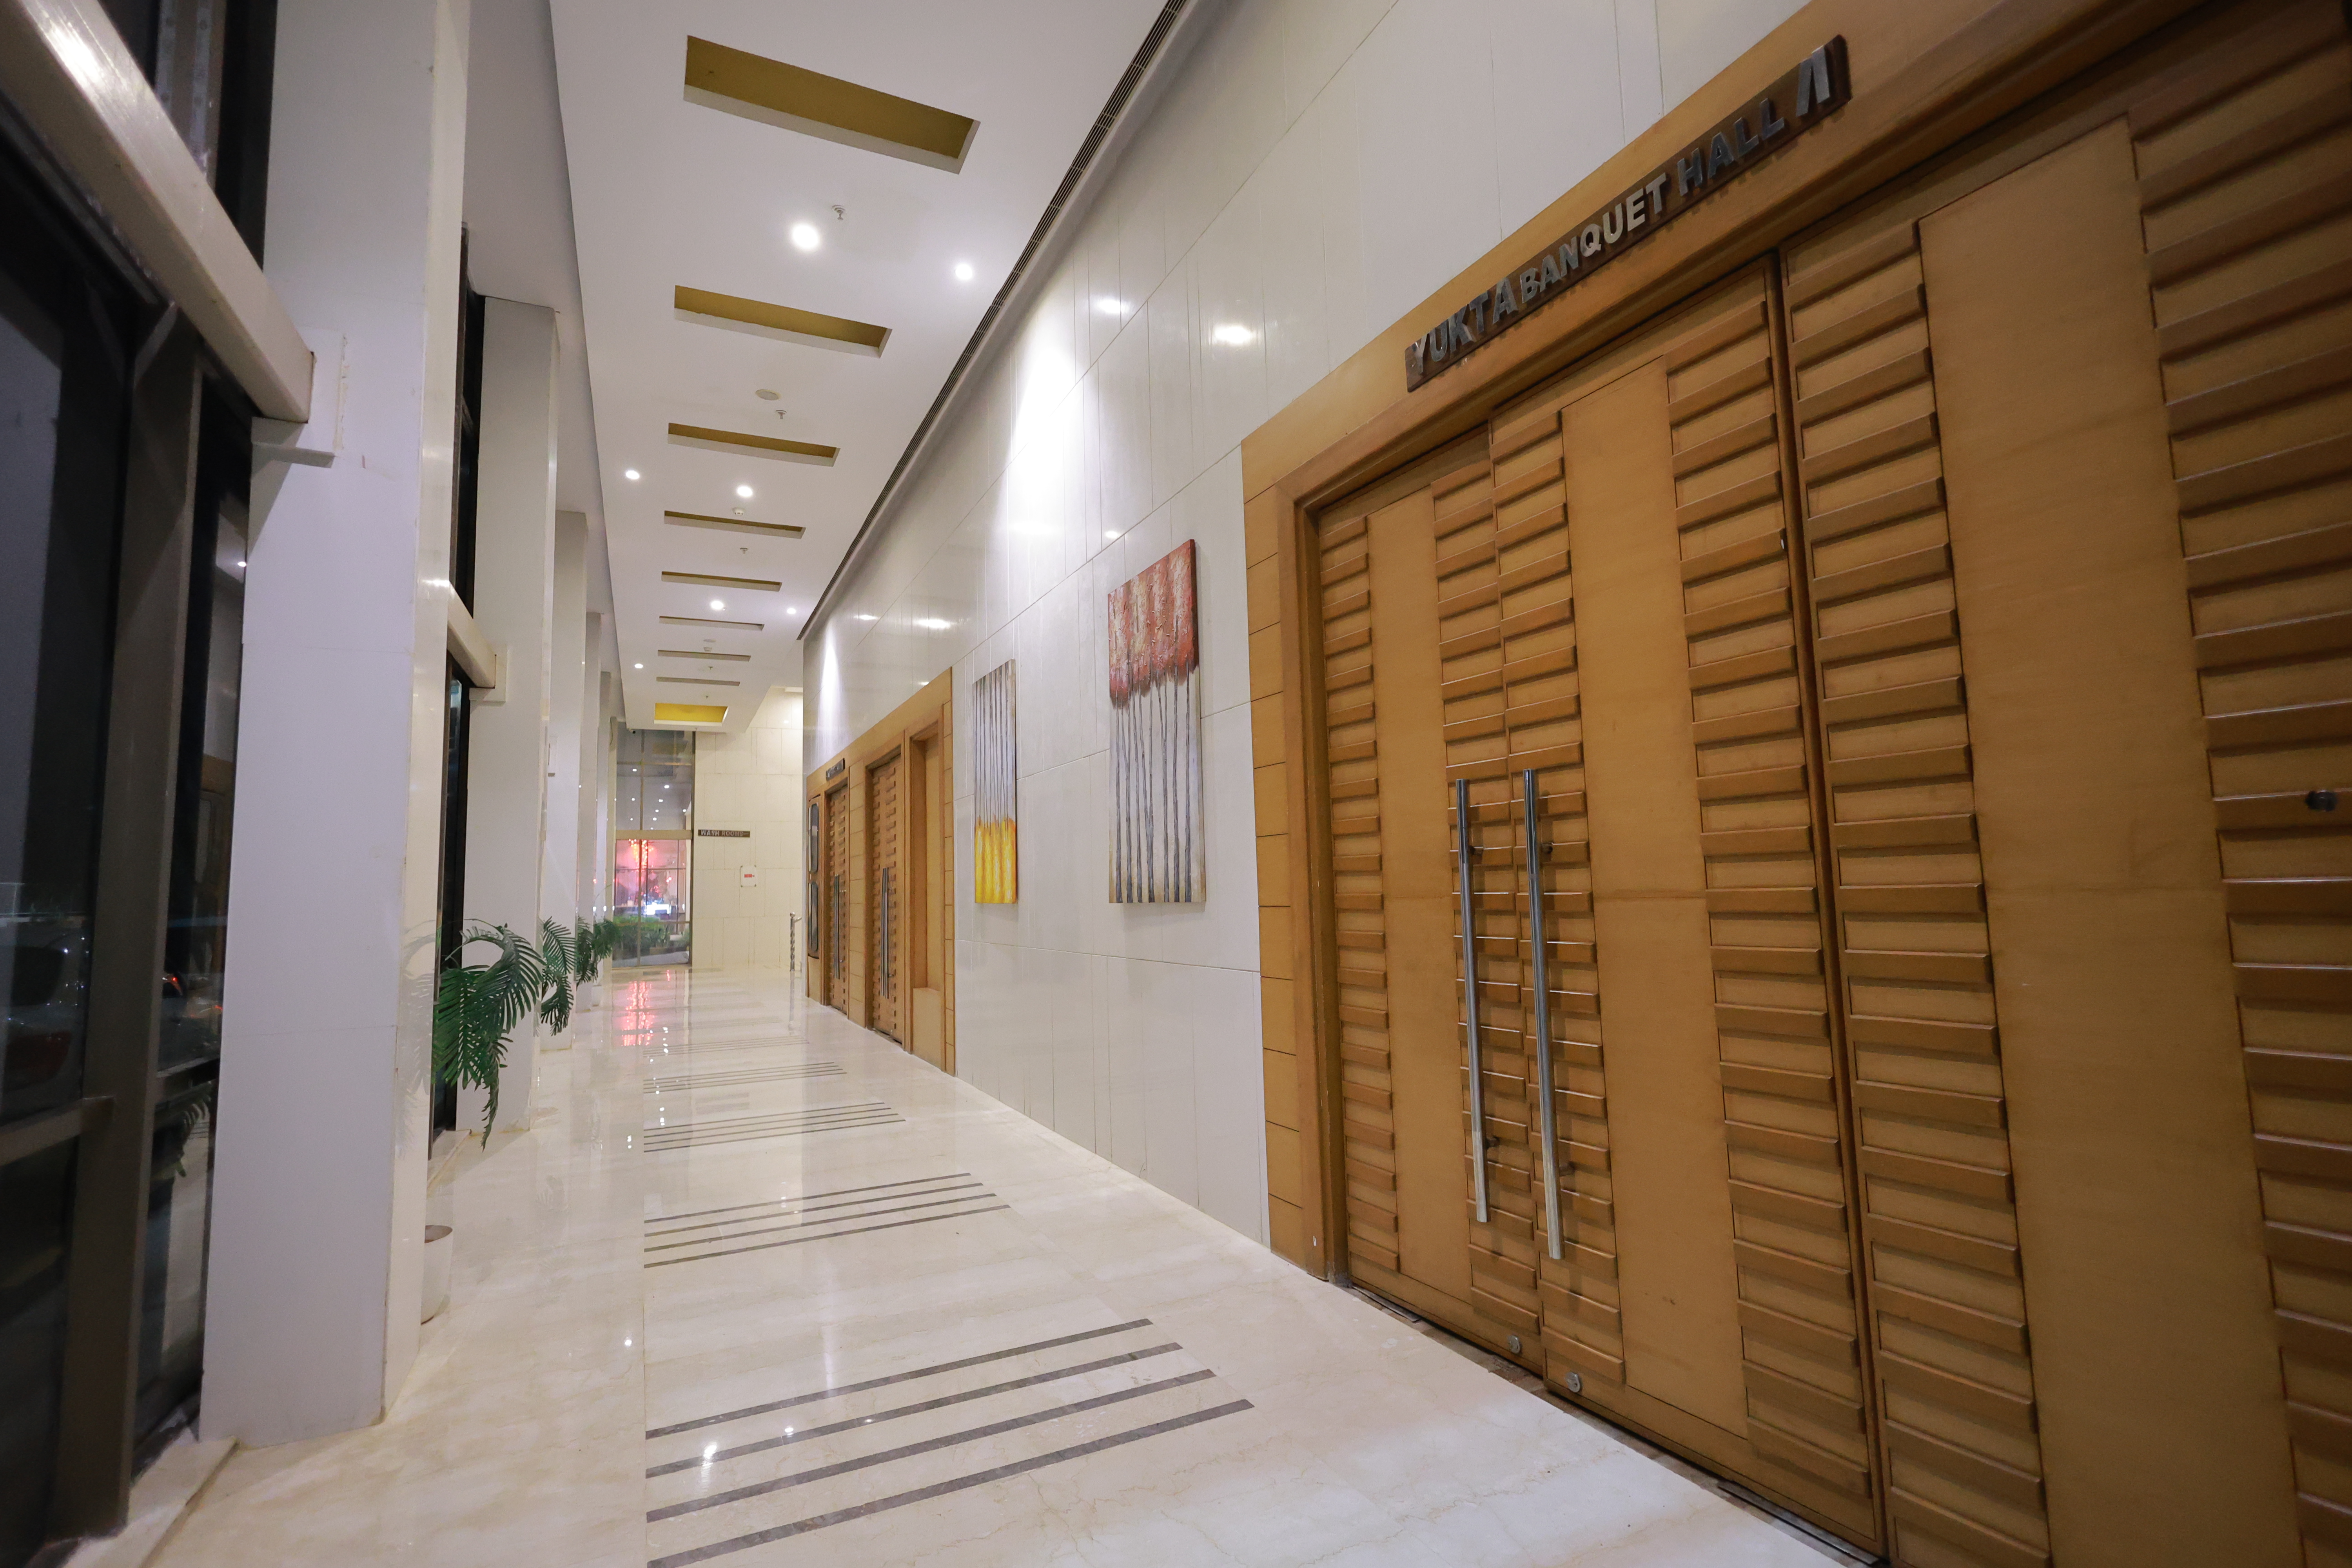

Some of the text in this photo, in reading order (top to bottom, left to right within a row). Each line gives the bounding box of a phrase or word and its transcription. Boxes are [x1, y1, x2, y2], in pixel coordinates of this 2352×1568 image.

[1413, 277, 1518, 375] YUKTA
[1520, 172, 1667, 303] BANQUET
[1677, 98, 1785, 196] HALL
